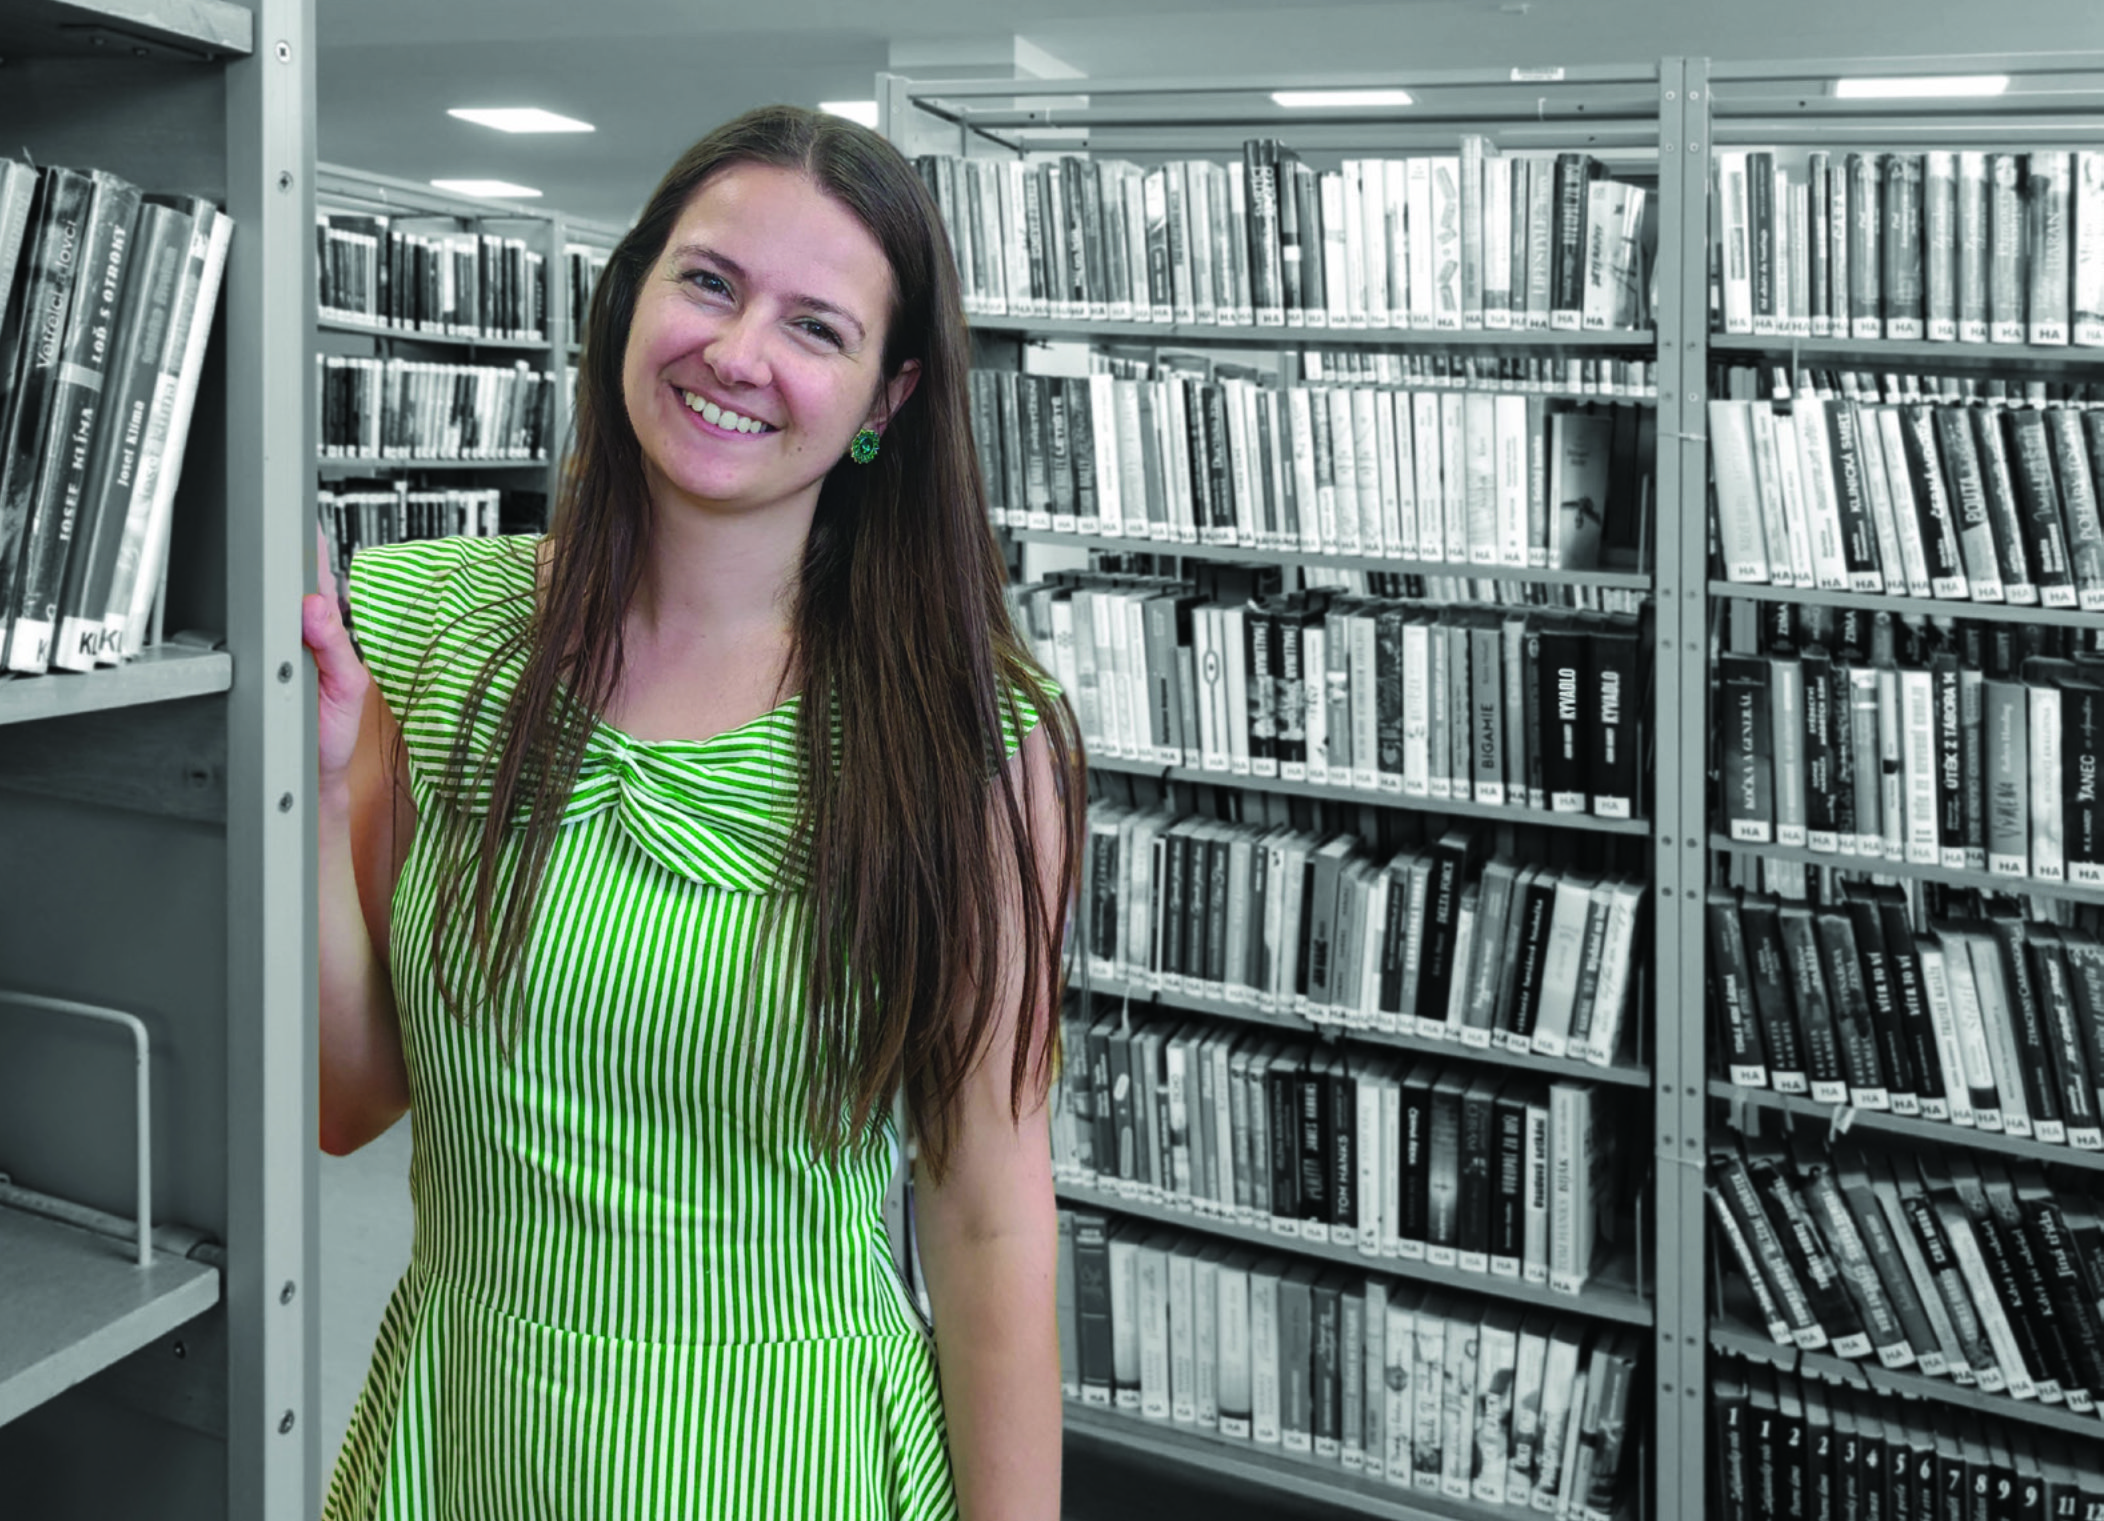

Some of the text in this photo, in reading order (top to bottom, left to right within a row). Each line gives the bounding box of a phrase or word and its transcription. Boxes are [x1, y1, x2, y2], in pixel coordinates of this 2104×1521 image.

[1438, 318, 1456, 328] HA
[1530, 320, 1548, 329] HA
[1587, 317, 1605, 327] HA
[2040, 330, 2060, 340] HA
[116, 449, 137, 487] Josef
[1839, 453, 1863, 513] KLINICKÁ
[58, 483, 80, 541] JOSEF
[1772, 571, 1790, 581] HA
[1821, 578, 1842, 588] HA
[1855, 579, 1876, 589] HA
[1978, 586, 1999, 596] HA
[2048, 591, 2070, 601] HA
[1558, 667, 1577, 721] KYVADLO
[1601, 670, 1620, 724] KYVADLO
[1942, 688, 1958, 738] TÁBORA
[1482, 702, 1495, 770] BIGAMIE
[1944, 740, 1957, 750] Z
[1943, 755, 1959, 790] ÚTĚK
[1479, 786, 1498, 796] HA
[1741, 825, 1761, 836] HA
[1812, 835, 1831, 845] HA
[1999, 861, 2020, 872] HA
[2040, 865, 2061, 877] HA
[2078, 867, 2100, 880] HA
[1740, 1069, 1761, 1081] HA
[1780, 1079, 1802, 1091] HA
[1820, 1087, 1840, 1097] HA
[1861, 1094, 1880, 1104] HA
[1894, 1098, 1915, 1110] HA
[1920, 1104, 1942, 1115] HA
[1978, 1112, 1998, 1123] HA
[2076, 1134, 2100, 1146] HA
[1336, 1134, 1350, 1216] TOM HANKS
[1553, 1280, 1571, 1291] HA
[1840, 1340, 1860, 1352] HA
[1885, 1349, 1904, 1361] HA
[1729, 1407, 1738, 1426] 1
[1760, 1420, 1770, 1438] 1
[1789, 1427, 1800, 1447] 2
[1817, 1436, 1829, 1456] 2
[1844, 1441, 1855, 1462] 3
[1866, 1449, 1878, 1468] 4
[1894, 1453, 1906, 1475] 5
[1919, 1458, 1931, 1479] 6
[1948, 1469, 1960, 1490] 7
[1975, 1474, 1988, 1494] 8
[1998, 1479, 2011, 1500] 9
[2024, 1486, 2037, 1508] 9
[2057, 1495, 2077, 1516] 11
